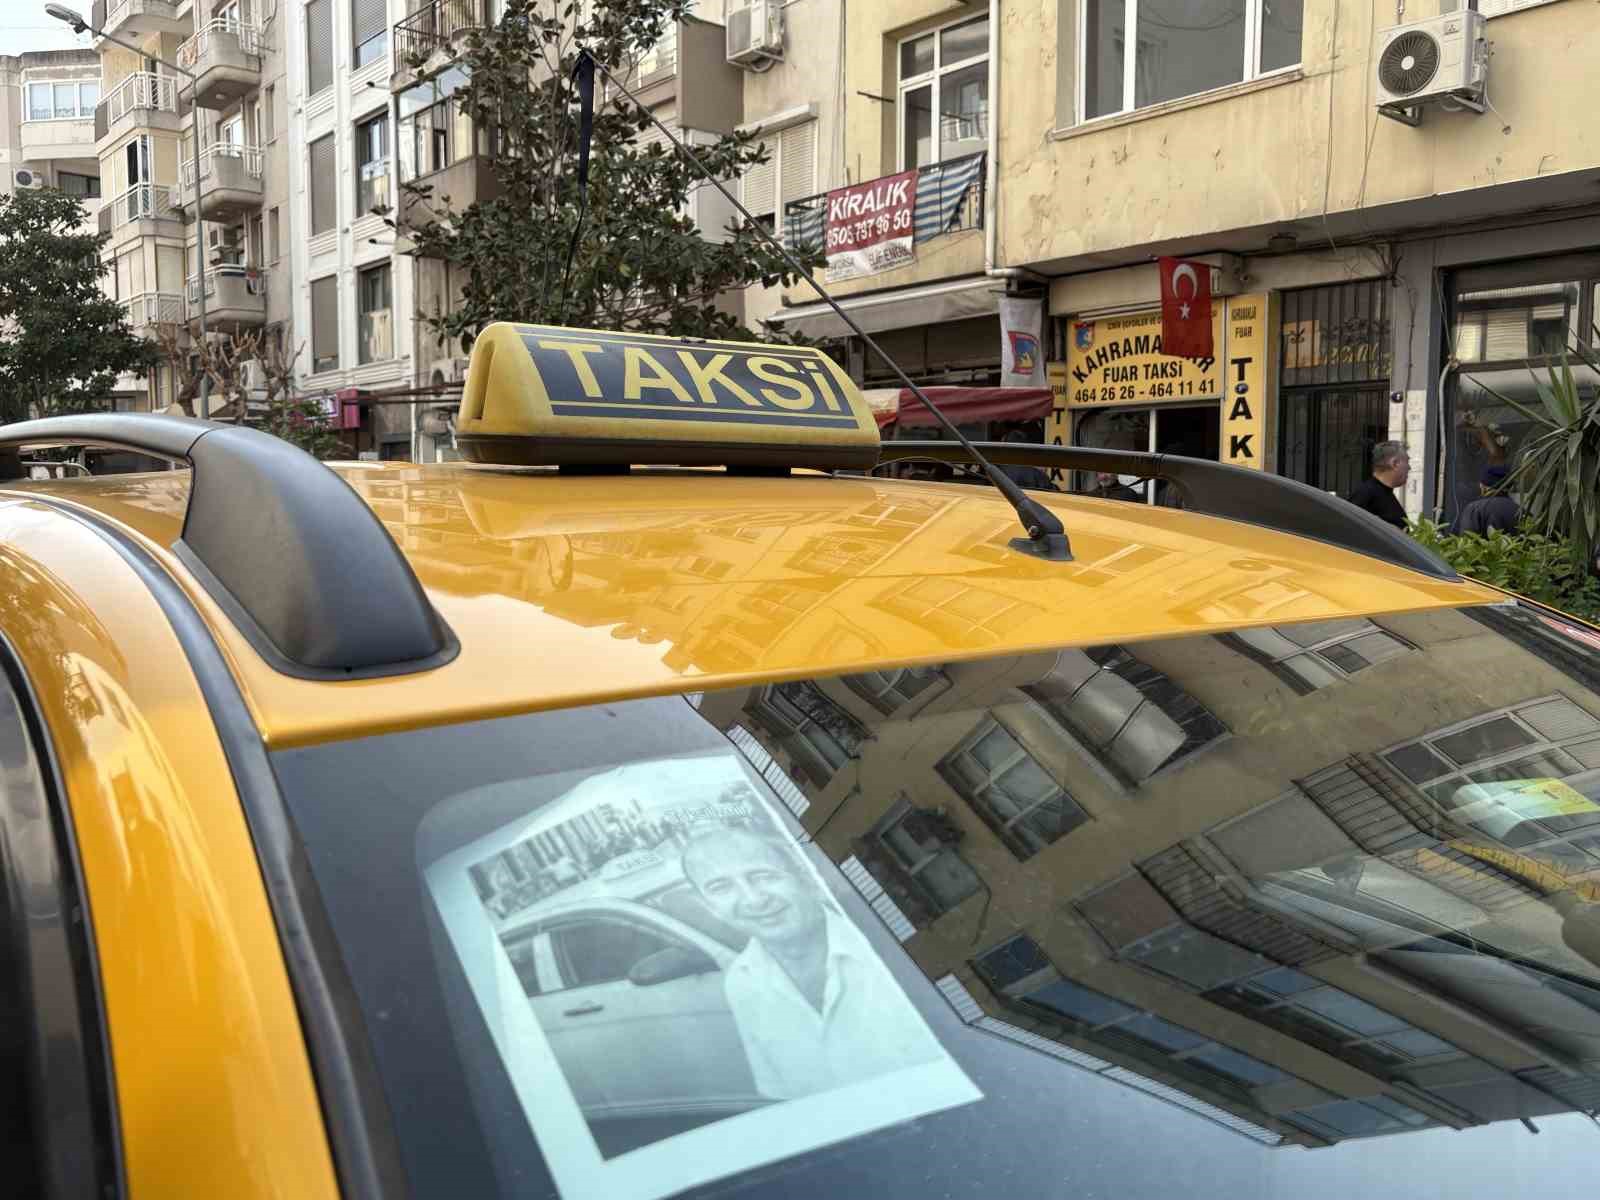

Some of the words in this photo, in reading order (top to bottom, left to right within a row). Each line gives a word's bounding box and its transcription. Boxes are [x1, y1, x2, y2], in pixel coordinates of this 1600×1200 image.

[830, 179, 911, 222] KİRALIK
[893, 209, 910, 231] 50
[1235, 326, 1253, 339] FUAR
[1072, 335, 1215, 384] KAHRAMAR
[1103, 365, 1138, 384] FUAR
[1075, 388, 1096, 402] 464
[1101, 387, 1115, 400] 26
[1120, 386, 1135, 399] 26
[1149, 383, 1172, 397] 464
[1178, 381, 1193, 395] 11
[1199, 379, 1215, 393] 41
